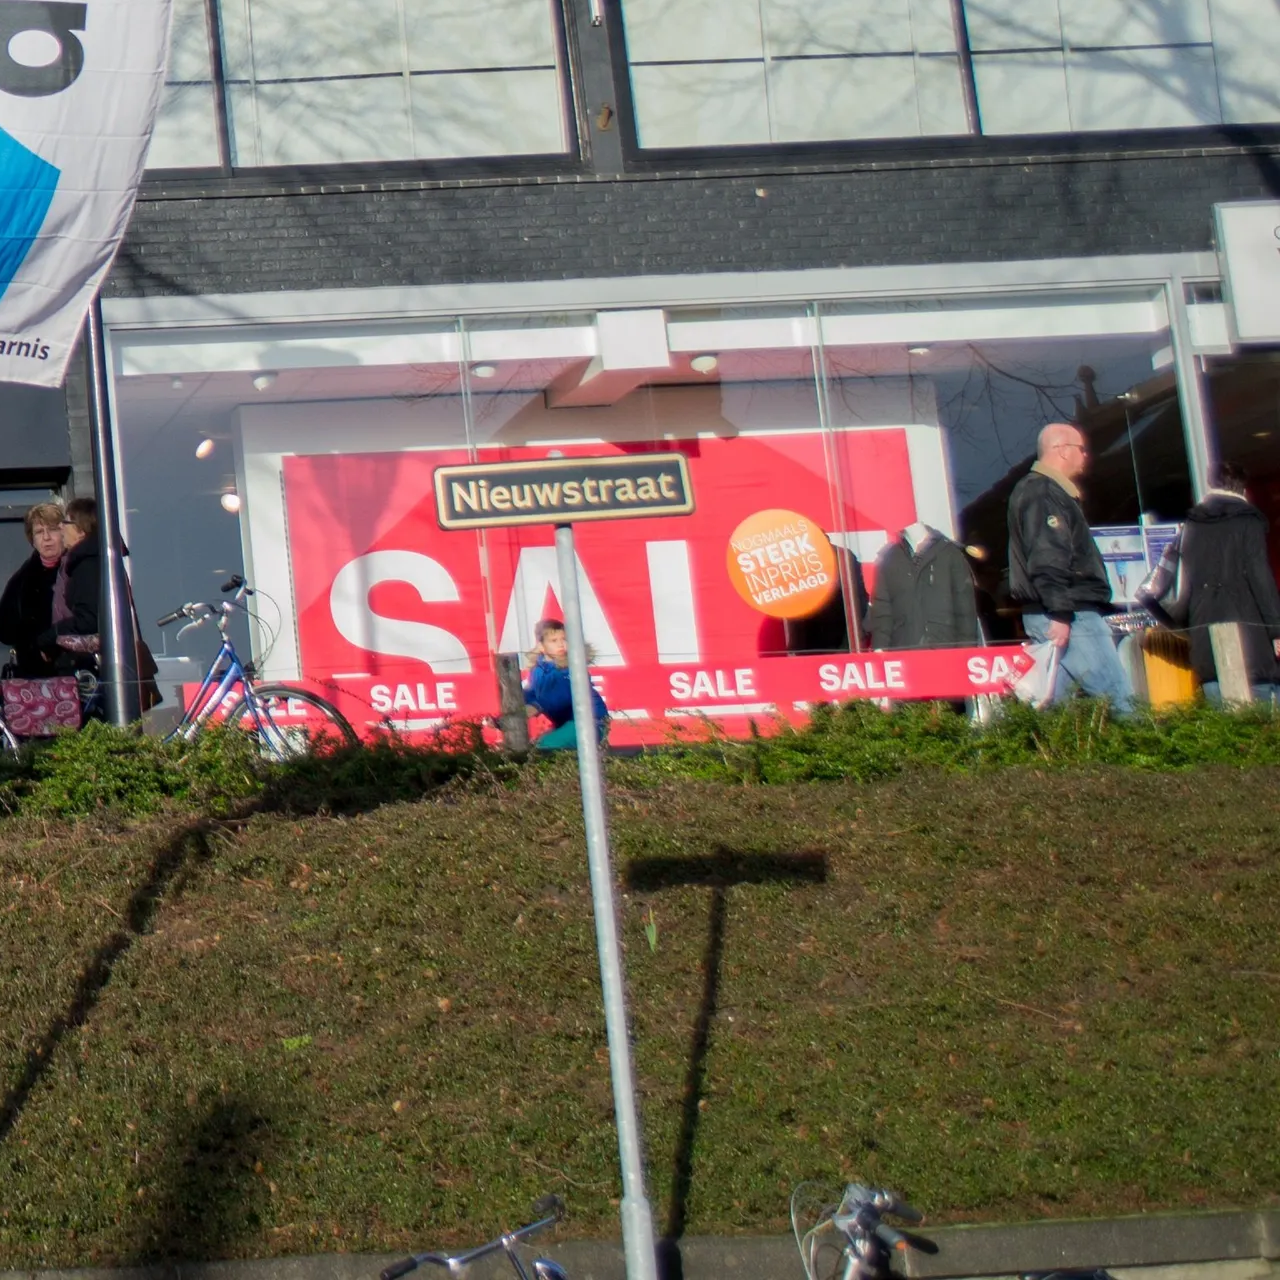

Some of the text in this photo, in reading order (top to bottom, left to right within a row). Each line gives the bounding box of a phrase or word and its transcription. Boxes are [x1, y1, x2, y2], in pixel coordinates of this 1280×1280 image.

[451, 472, 678, 514] Nieuwstraat
[730, 519, 808, 553] NOGMAALS
[737, 532, 816, 573] STERK
[752, 572, 829, 605] VERLAAGD
[669, 668, 757, 700] SALE
[818, 660, 906, 692] SALE
[220, 690, 307, 719] SE
[370, 681, 457, 713] SALE
